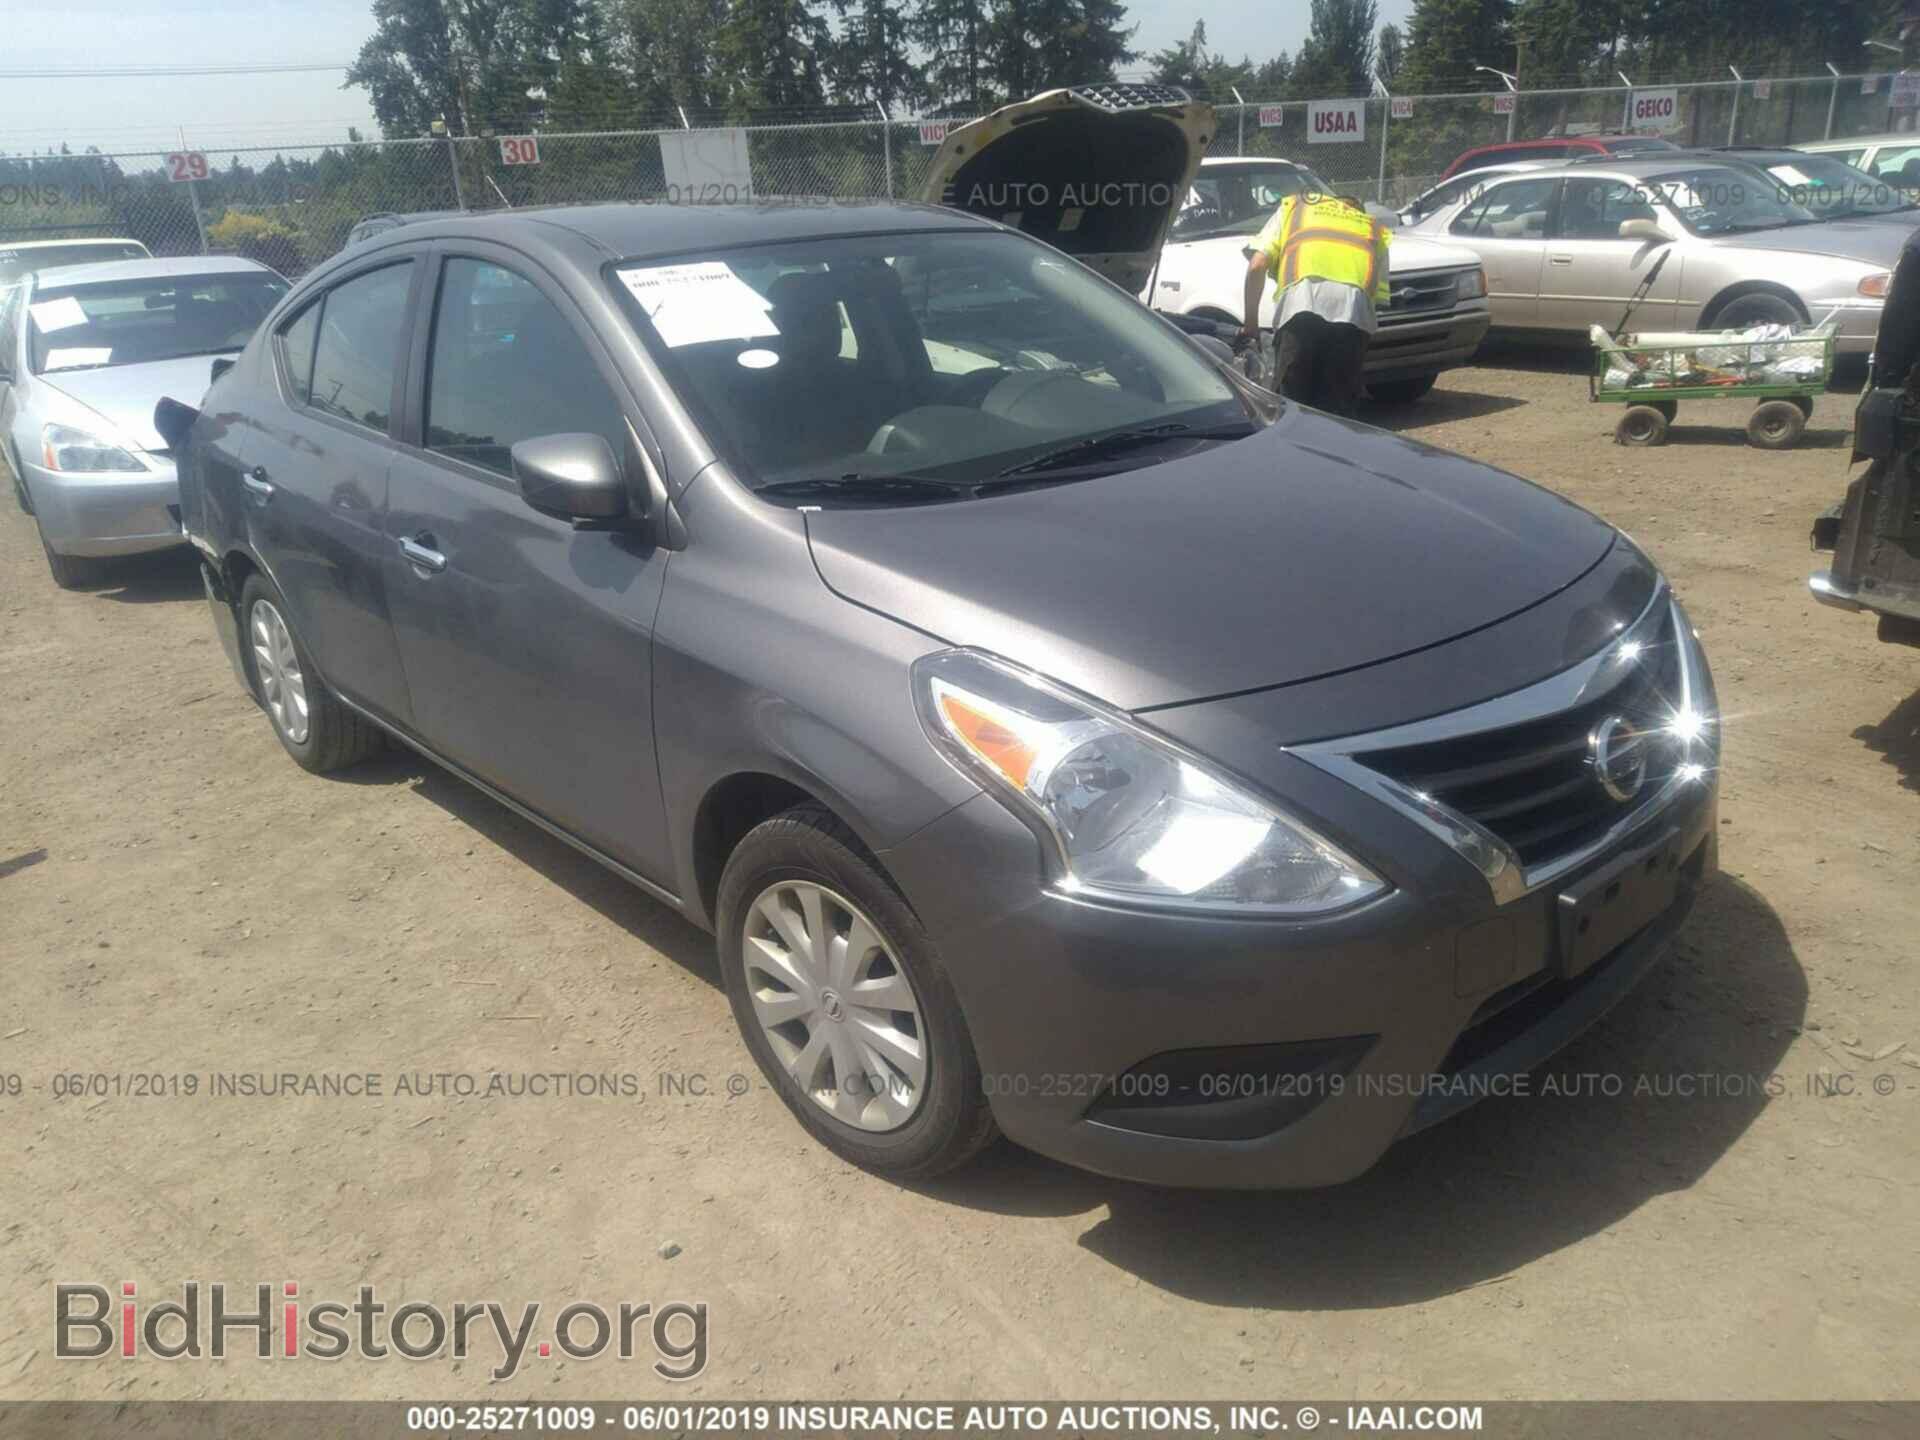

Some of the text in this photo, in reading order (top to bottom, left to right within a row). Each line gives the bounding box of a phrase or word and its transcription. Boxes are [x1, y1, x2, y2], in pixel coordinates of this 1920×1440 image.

[1636, 97, 1672, 118] GEICO
[1315, 111, 1357, 133] USAA
[503, 140, 536, 162] 30
[169, 153, 207, 180] 29
